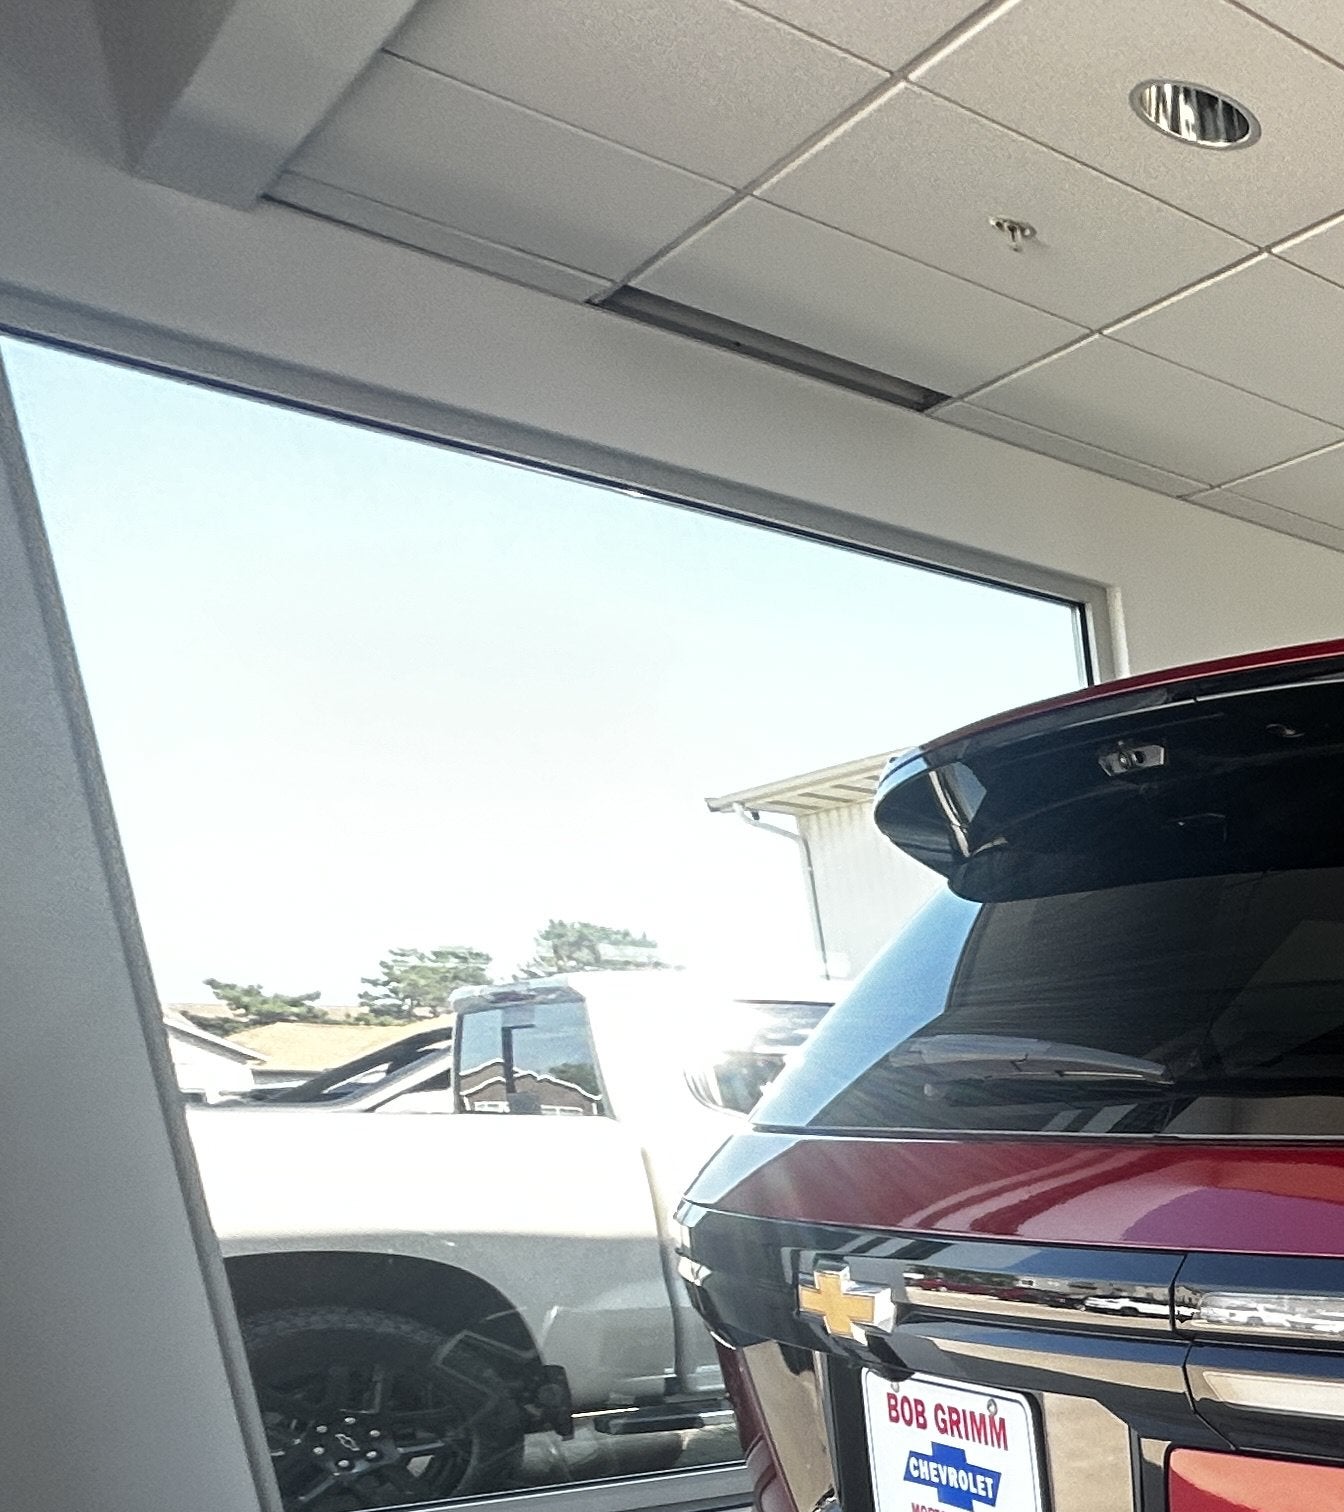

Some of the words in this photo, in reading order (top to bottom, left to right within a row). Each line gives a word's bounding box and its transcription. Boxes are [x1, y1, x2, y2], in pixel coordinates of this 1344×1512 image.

[886, 1392, 928, 1430] BOB
[934, 1402, 1009, 1452] GRIMM
[909, 1456, 994, 1499] CHEVROLET
